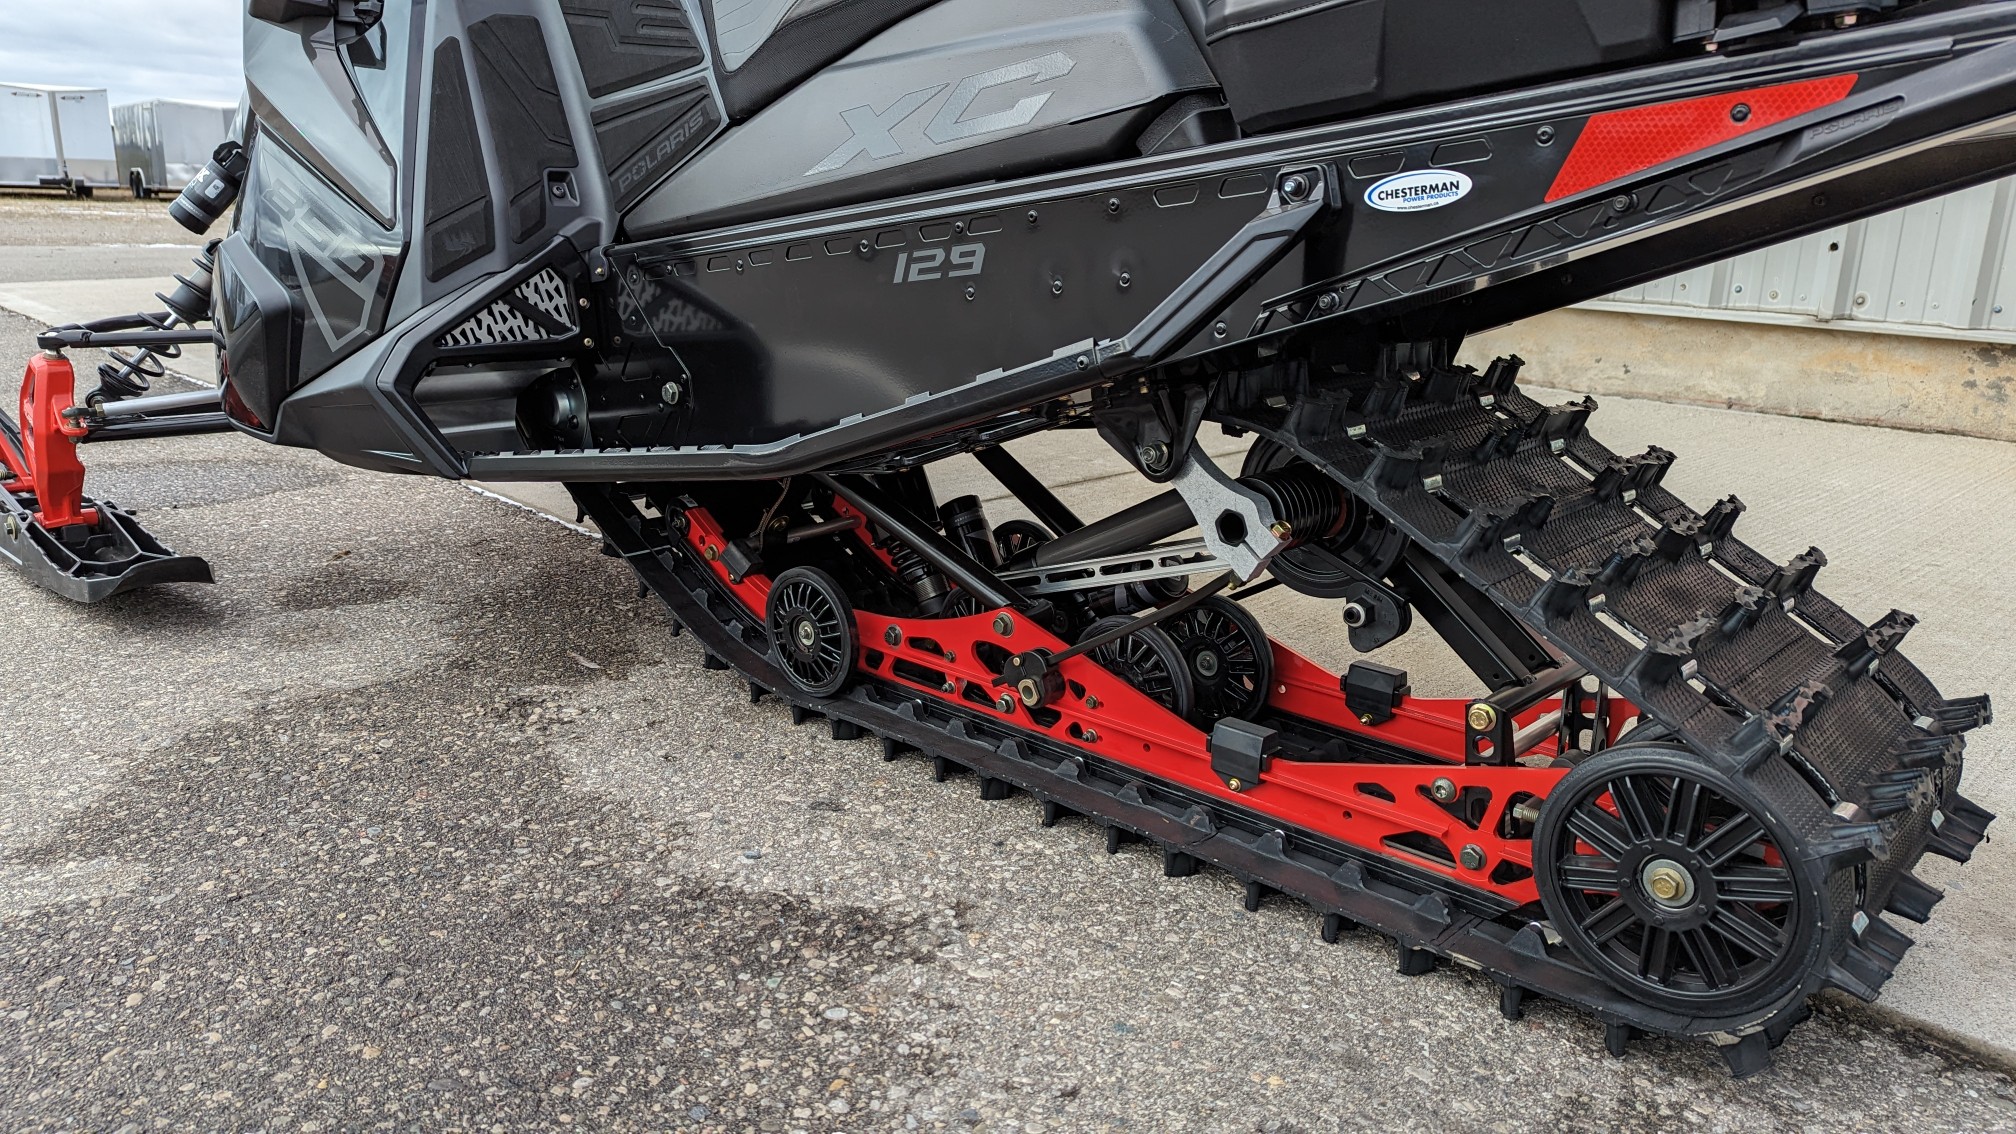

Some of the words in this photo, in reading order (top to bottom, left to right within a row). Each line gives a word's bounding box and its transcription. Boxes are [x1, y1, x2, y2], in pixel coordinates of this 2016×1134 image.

[802, 50, 1077, 177] XC
[1809, 103, 1900, 139] POLARIS
[619, 109, 704, 192] POLARIS
[1378, 180, 1460, 200] CHESTERMAN
[1403, 194, 1424, 203] POWER
[1427, 191, 1459, 200] PRODUCTS
[261, 178, 375, 284] 850
[893, 242, 985, 283] 129
